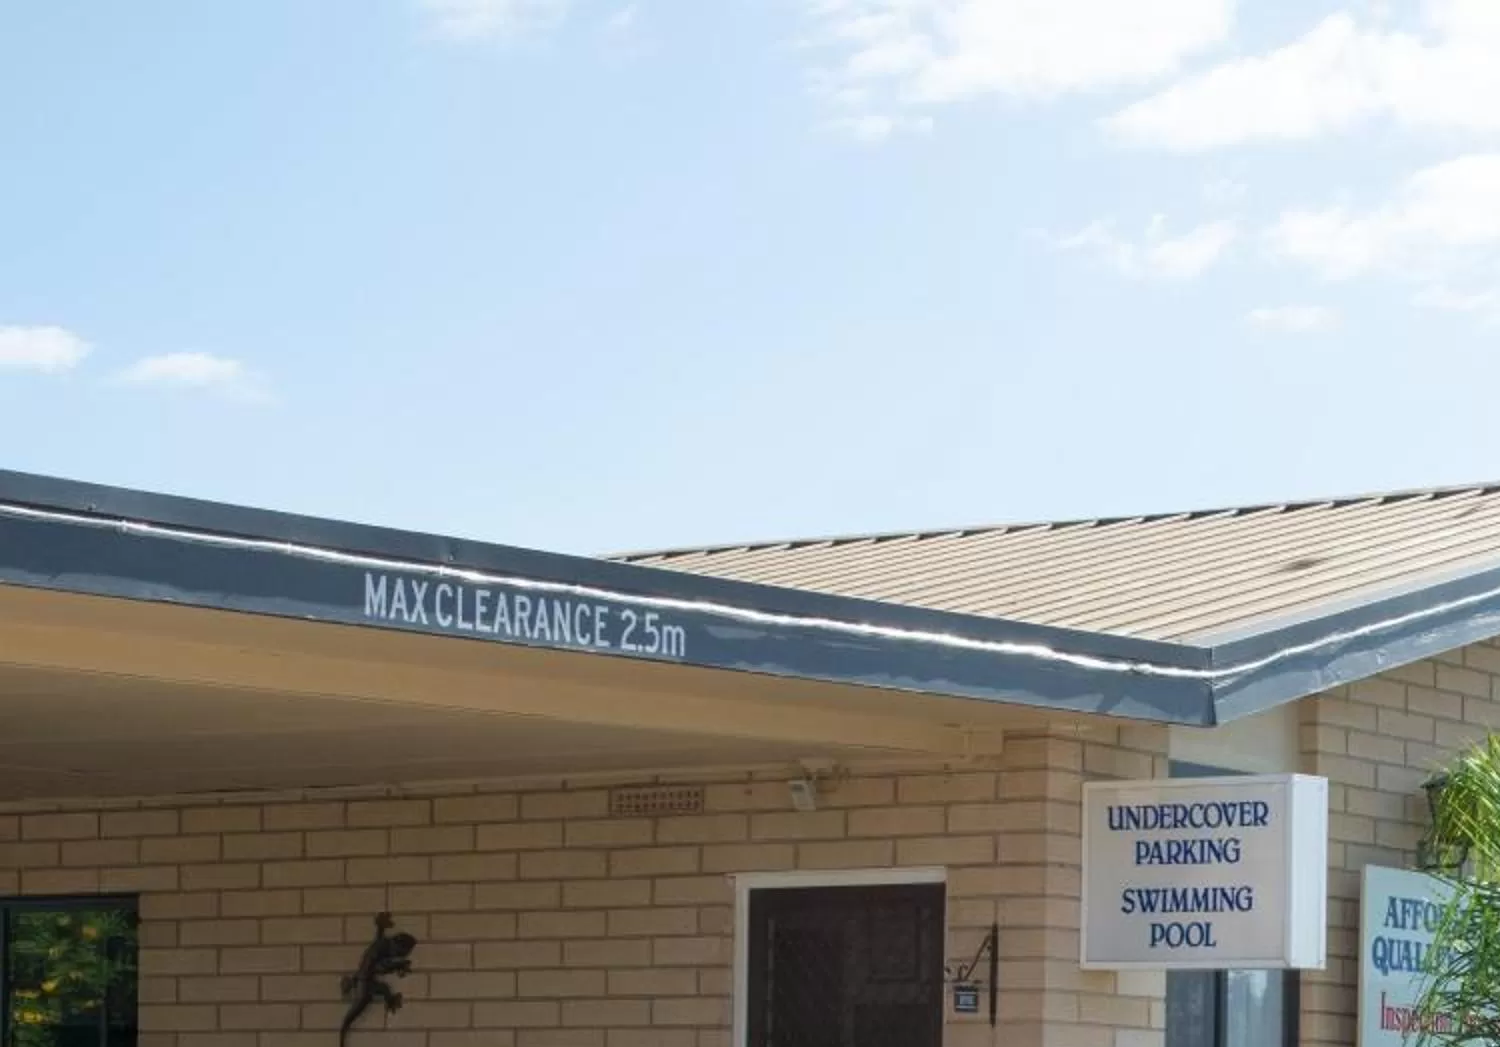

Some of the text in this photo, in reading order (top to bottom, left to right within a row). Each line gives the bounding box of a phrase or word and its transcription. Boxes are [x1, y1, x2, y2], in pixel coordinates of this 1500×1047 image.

[364, 572, 686, 657] MAX CLEARANCE 2.5m
[1107, 801, 1269, 830] UNDERCOVER
[1136, 838, 1241, 865] PARKING
[1121, 886, 1253, 914] SWIMMING
[1149, 922, 1217, 948] POOL
